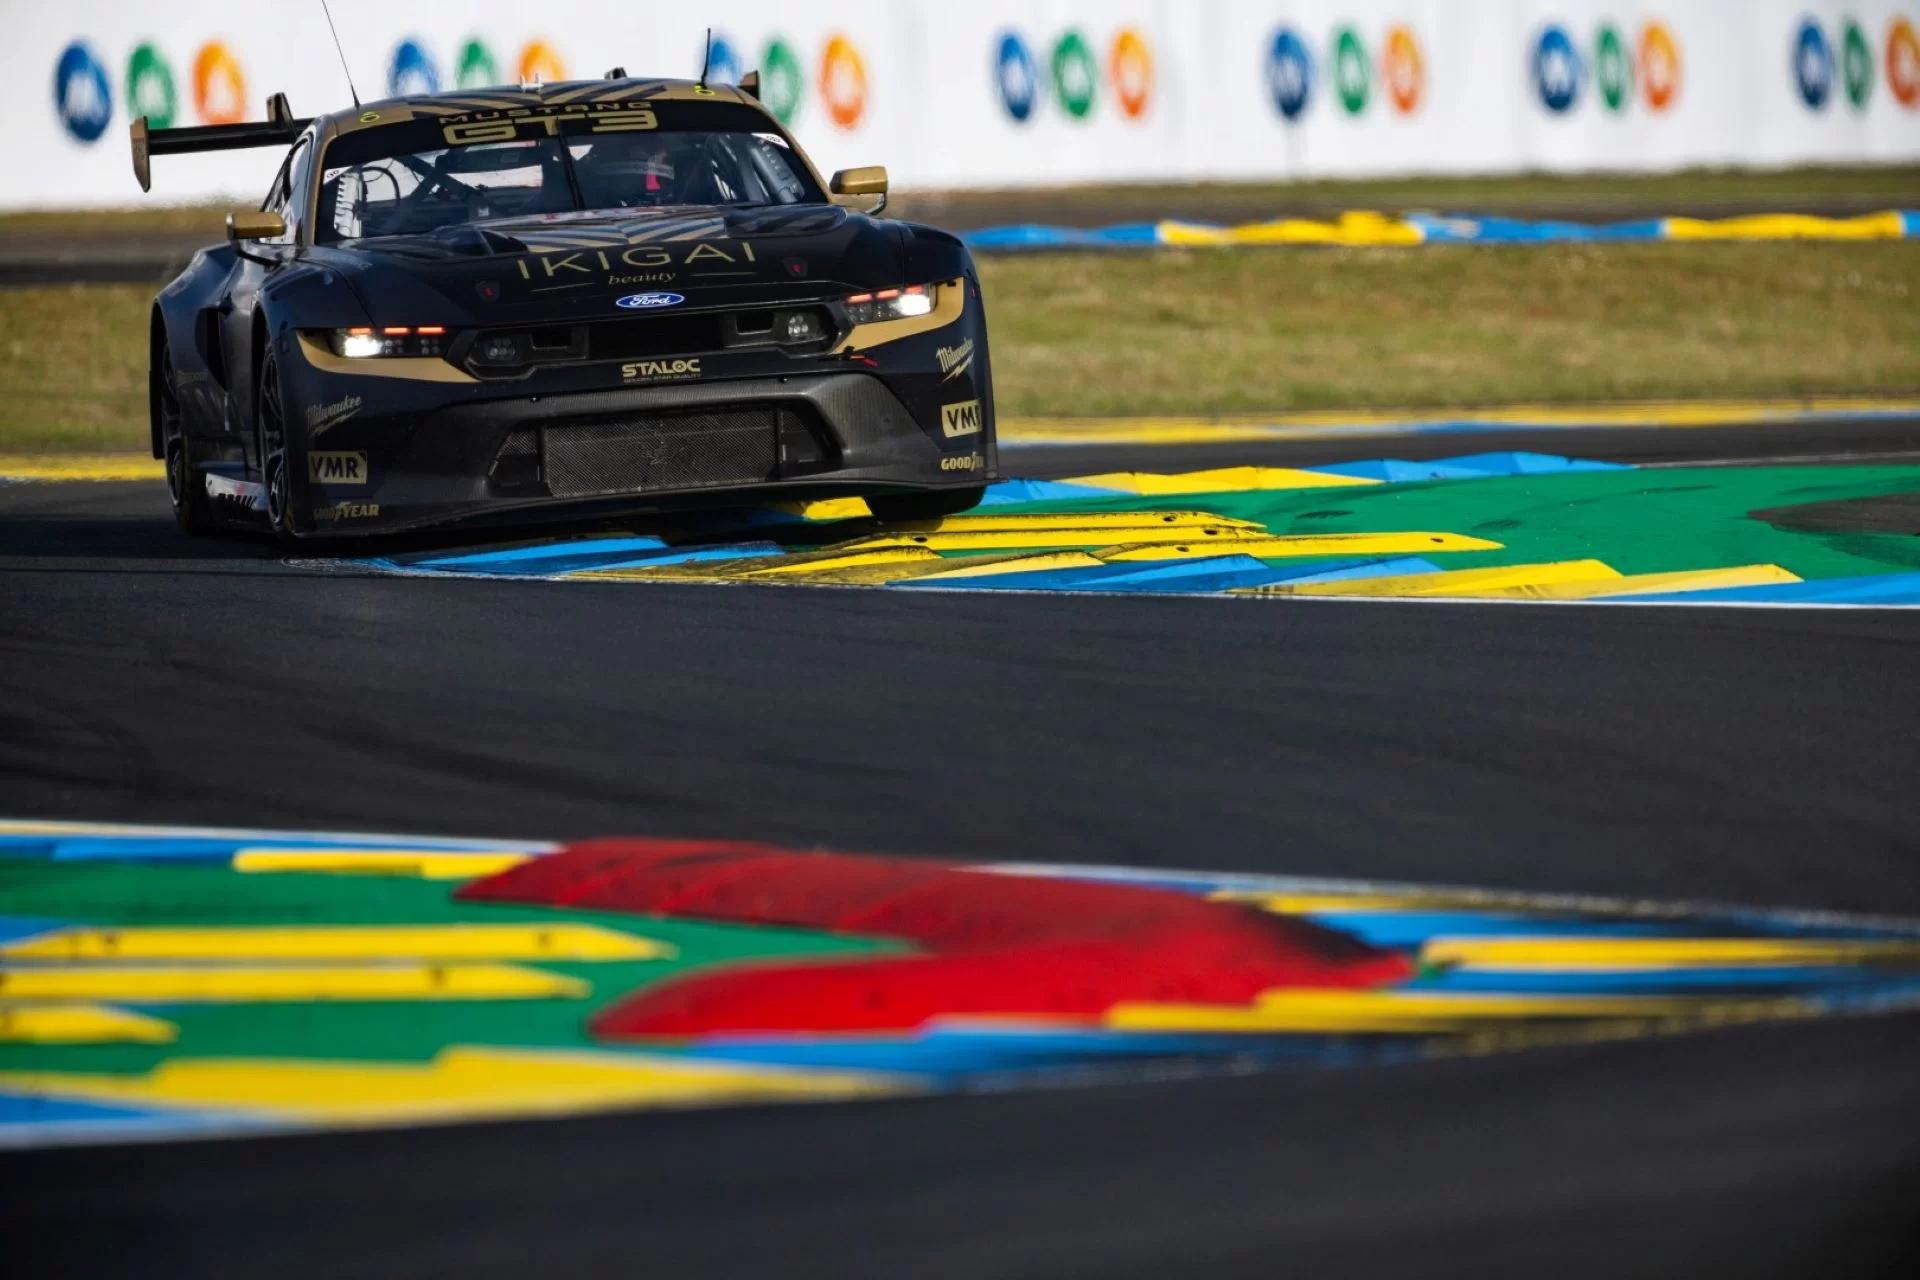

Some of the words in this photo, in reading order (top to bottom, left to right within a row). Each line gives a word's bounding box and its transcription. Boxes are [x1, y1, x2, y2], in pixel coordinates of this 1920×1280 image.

[440, 102, 652, 124] MUSTANG
[444, 110, 658, 145] GT3
[517, 241, 756, 280] IKIGAI
[608, 272, 676, 286] beauty
[629, 293, 671, 307] Ford
[621, 358, 701, 378] STALOC
[311, 456, 359, 479] VMR
